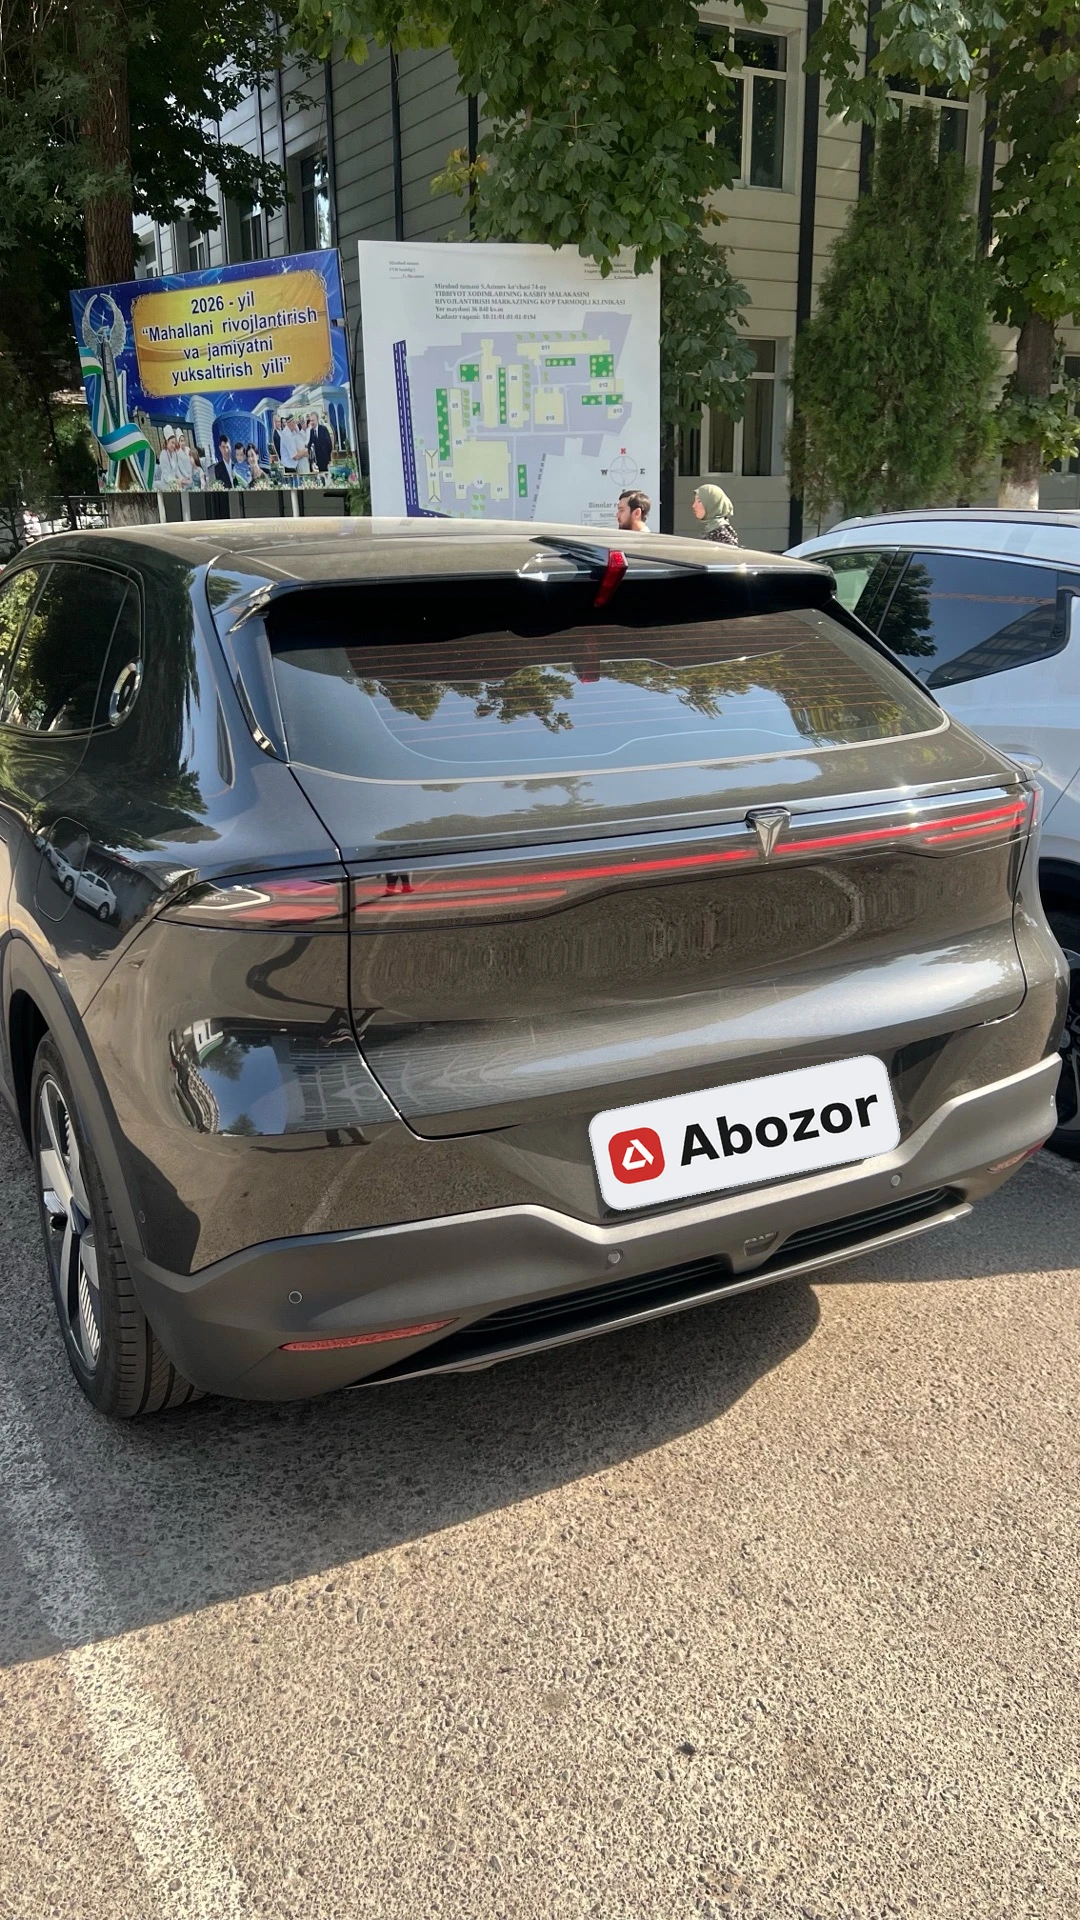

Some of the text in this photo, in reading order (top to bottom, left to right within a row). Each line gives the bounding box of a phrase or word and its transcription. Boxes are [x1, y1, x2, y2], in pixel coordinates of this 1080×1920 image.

[191, 295, 224, 314] 2026
[238, 291, 255, 312] yil
[222, 307, 317, 335] rivojlantirish
[183, 336, 273, 361] va jamiyatni
[172, 362, 253, 386] yuksaltirish
